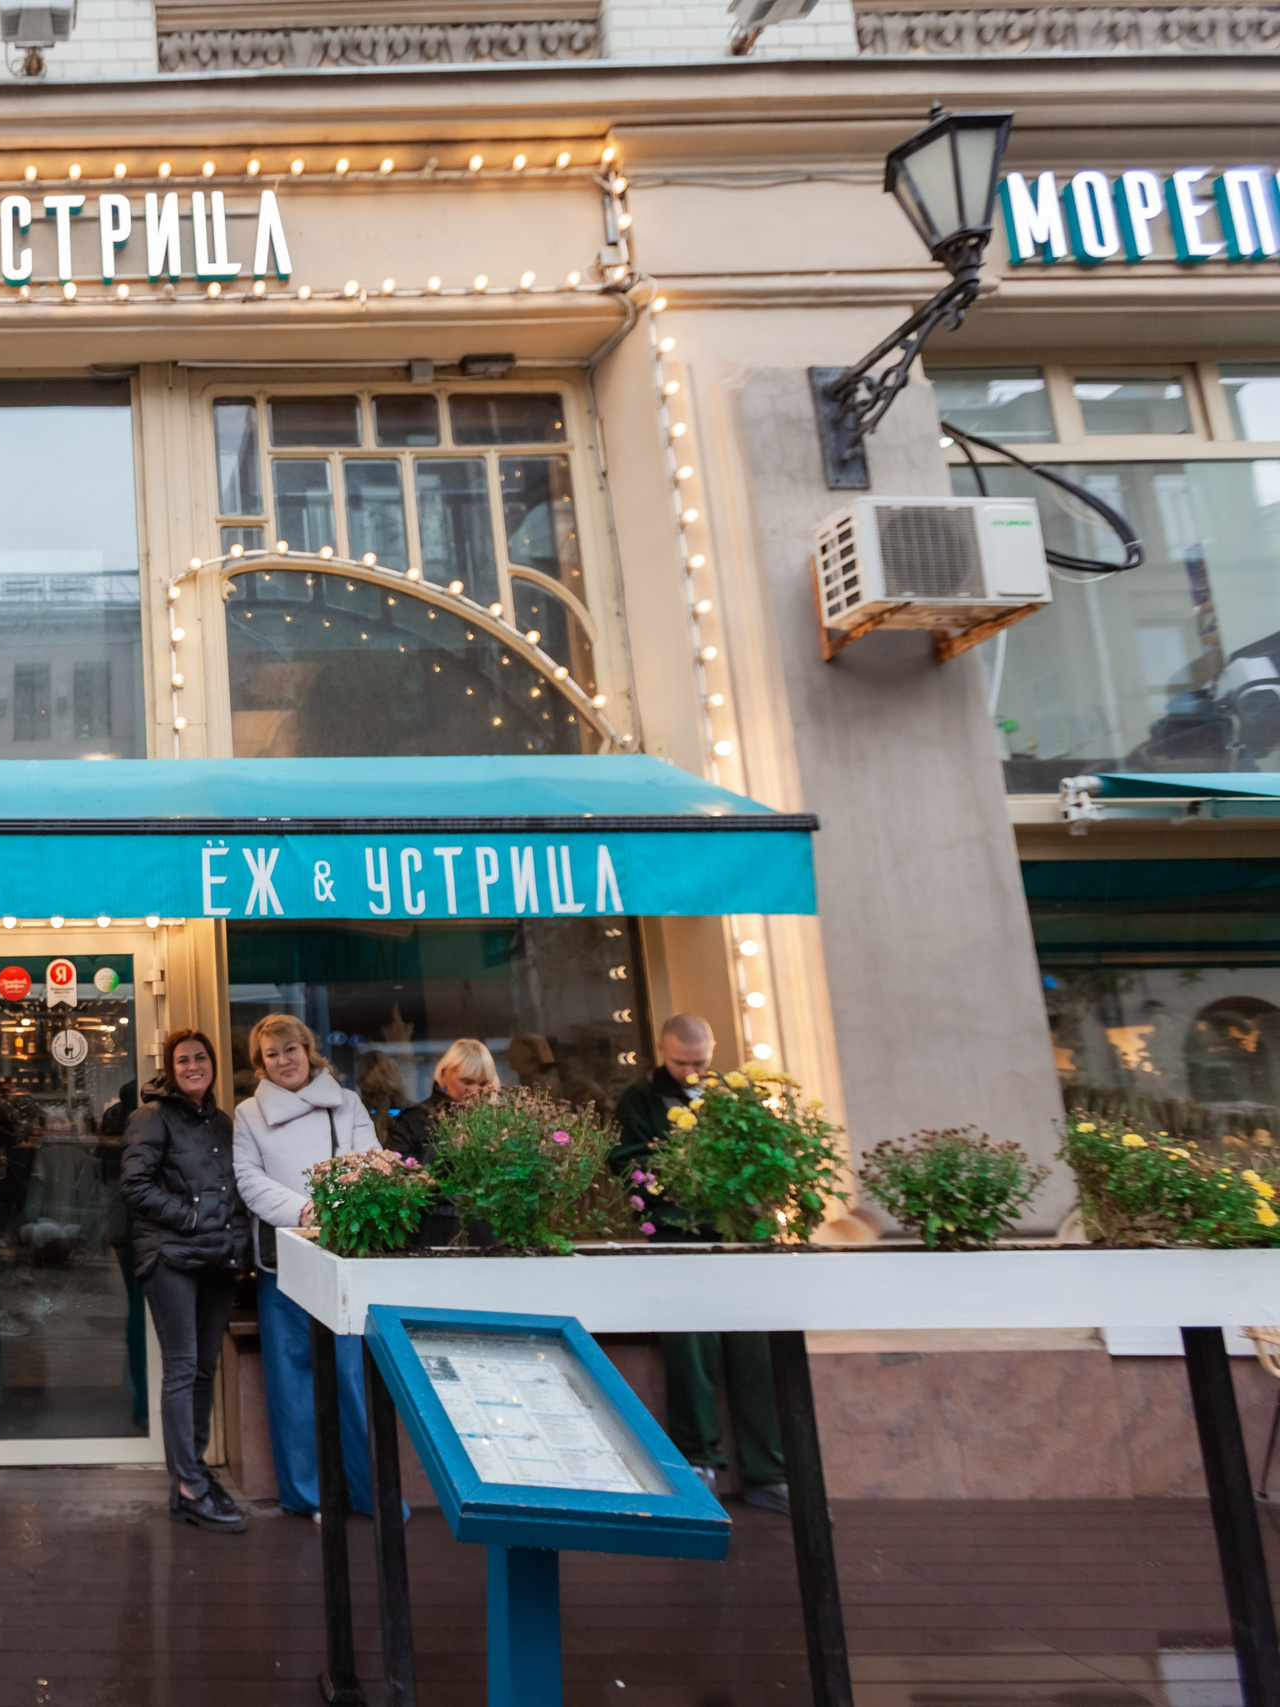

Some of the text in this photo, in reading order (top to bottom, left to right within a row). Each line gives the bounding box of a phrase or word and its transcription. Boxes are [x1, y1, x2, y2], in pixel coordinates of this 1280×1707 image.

[999, 164, 1280, 264] МОРЕП
[201, 839, 624, 916] ЁЖ & УСТРИЦА
